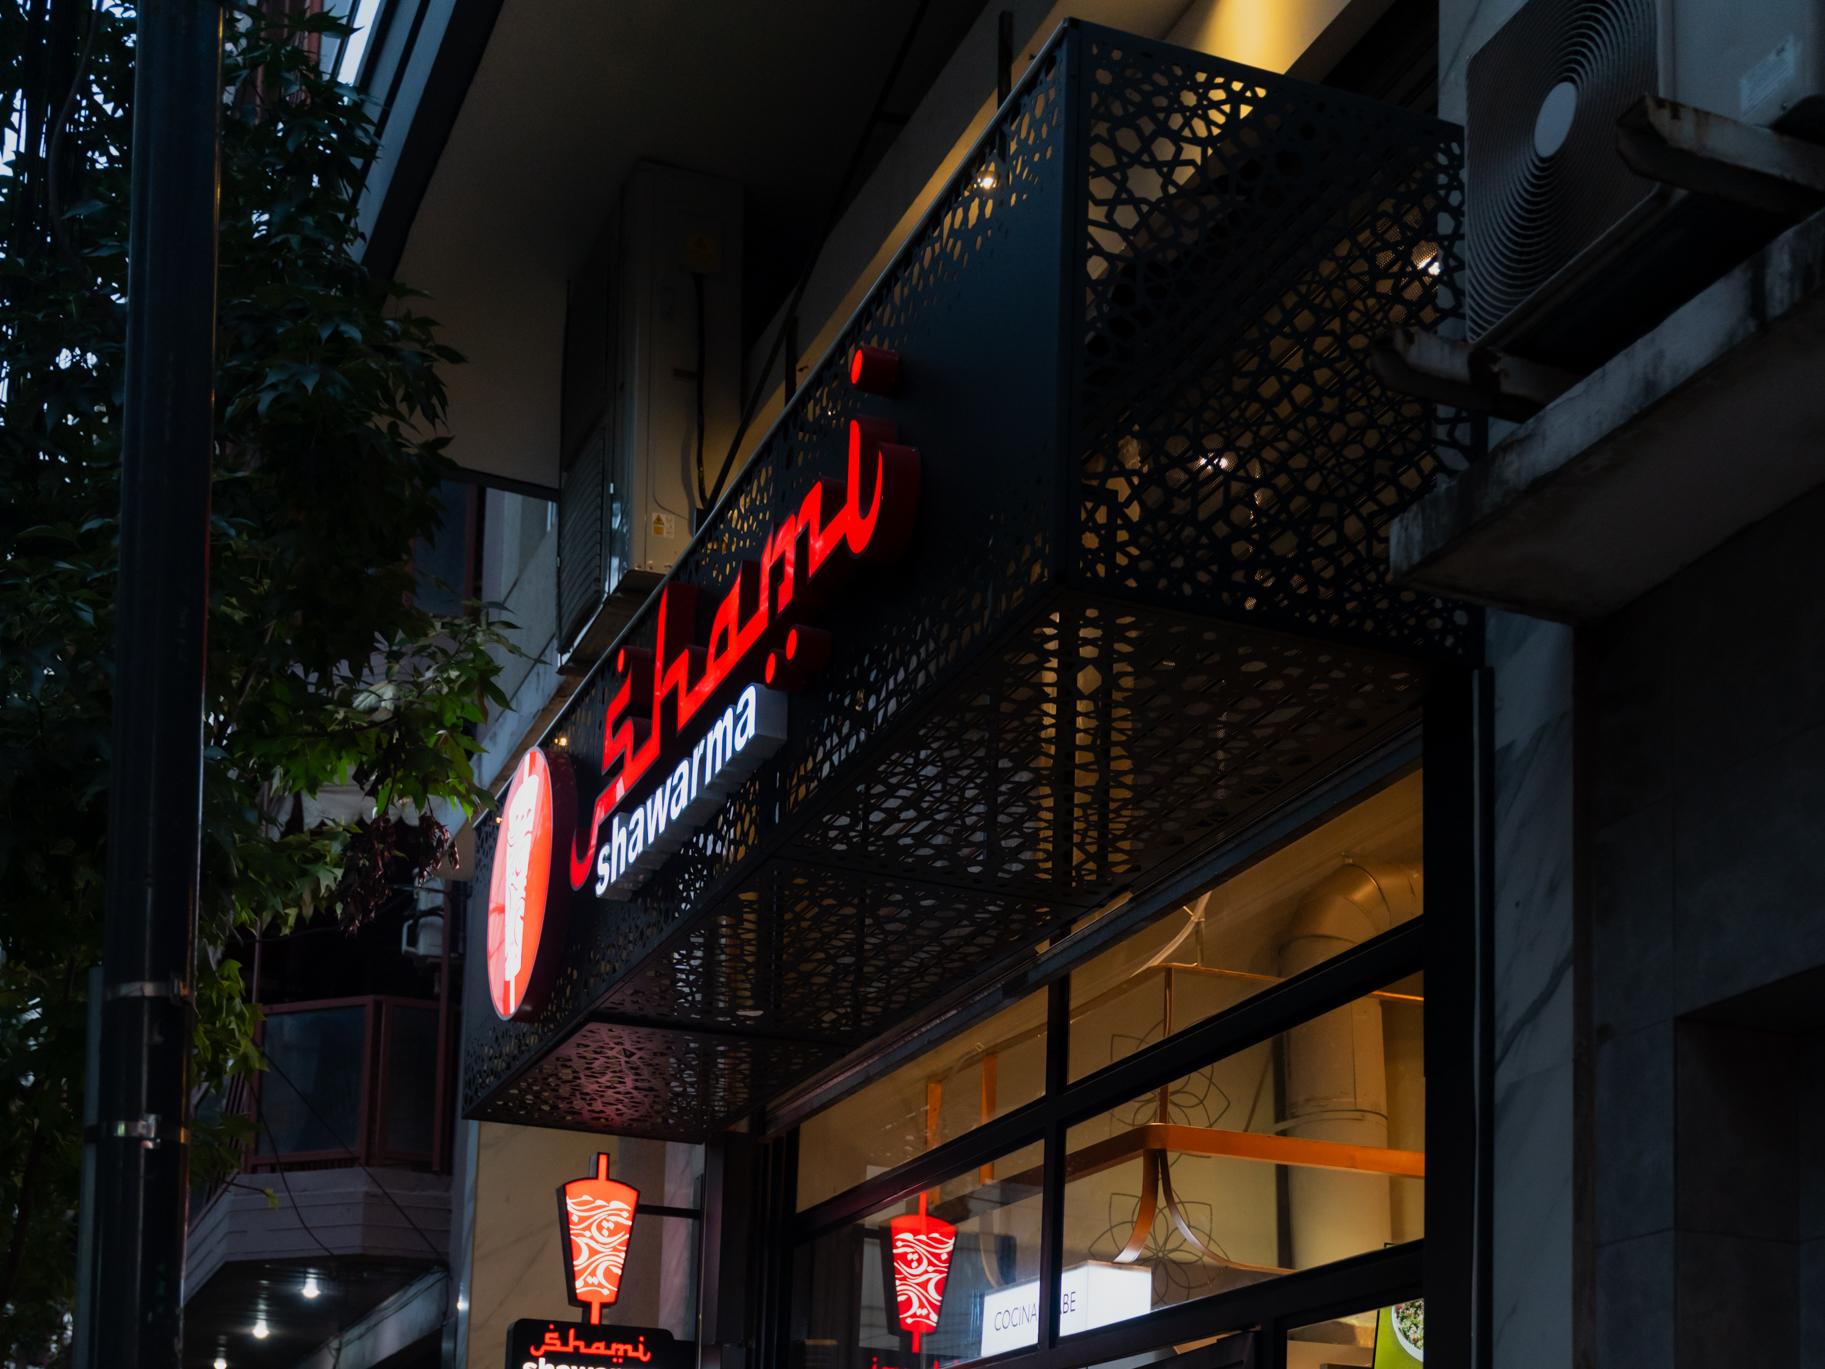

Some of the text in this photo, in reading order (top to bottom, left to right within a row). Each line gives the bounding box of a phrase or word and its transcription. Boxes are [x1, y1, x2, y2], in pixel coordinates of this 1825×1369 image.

[595, 683, 757, 899] shawarma
[994, 1302, 1038, 1331] COCINA
[530, 1324, 652, 1363] shami
